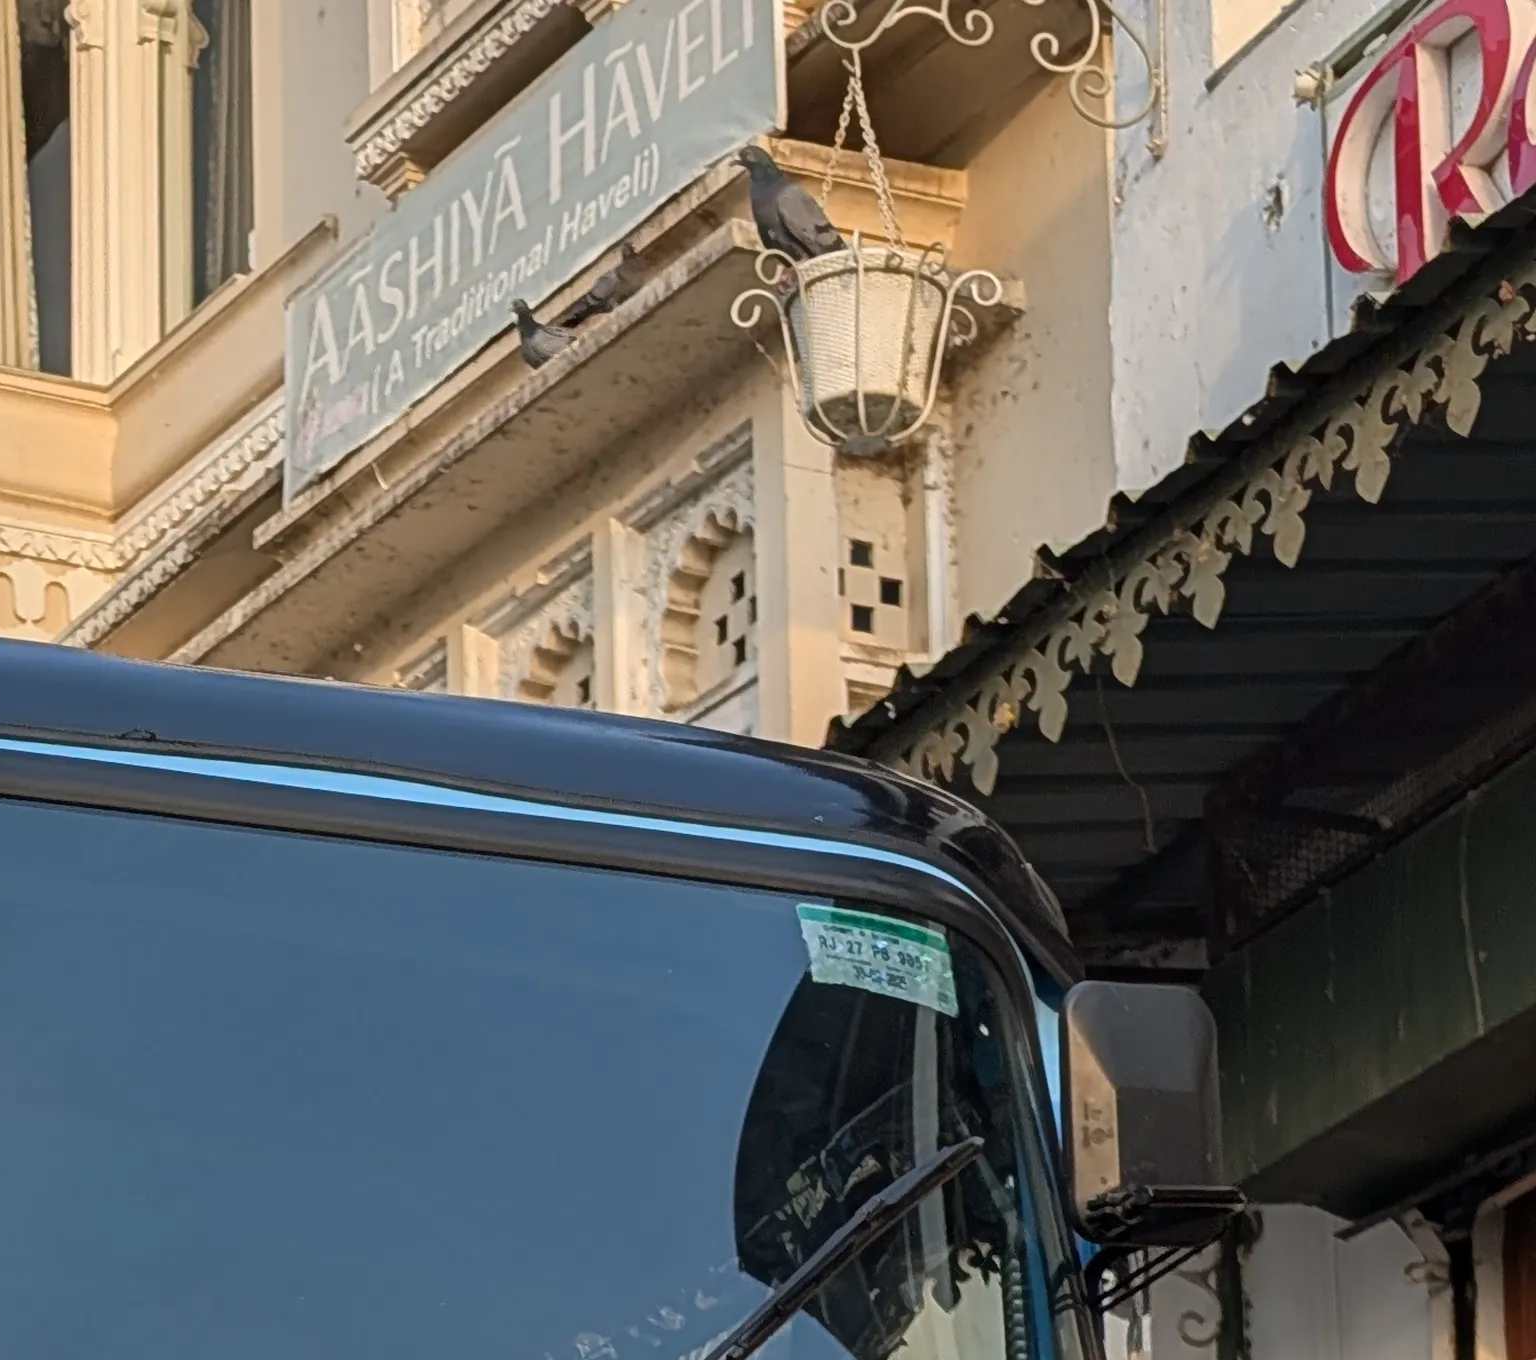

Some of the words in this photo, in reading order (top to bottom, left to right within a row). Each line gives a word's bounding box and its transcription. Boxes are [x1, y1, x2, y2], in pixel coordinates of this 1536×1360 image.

[411, 225, 554, 369] Traditional
[560, 142, 660, 252] Haveli)
[817, 935, 837, 951] RJ
[845, 940, 863, 955] 27
